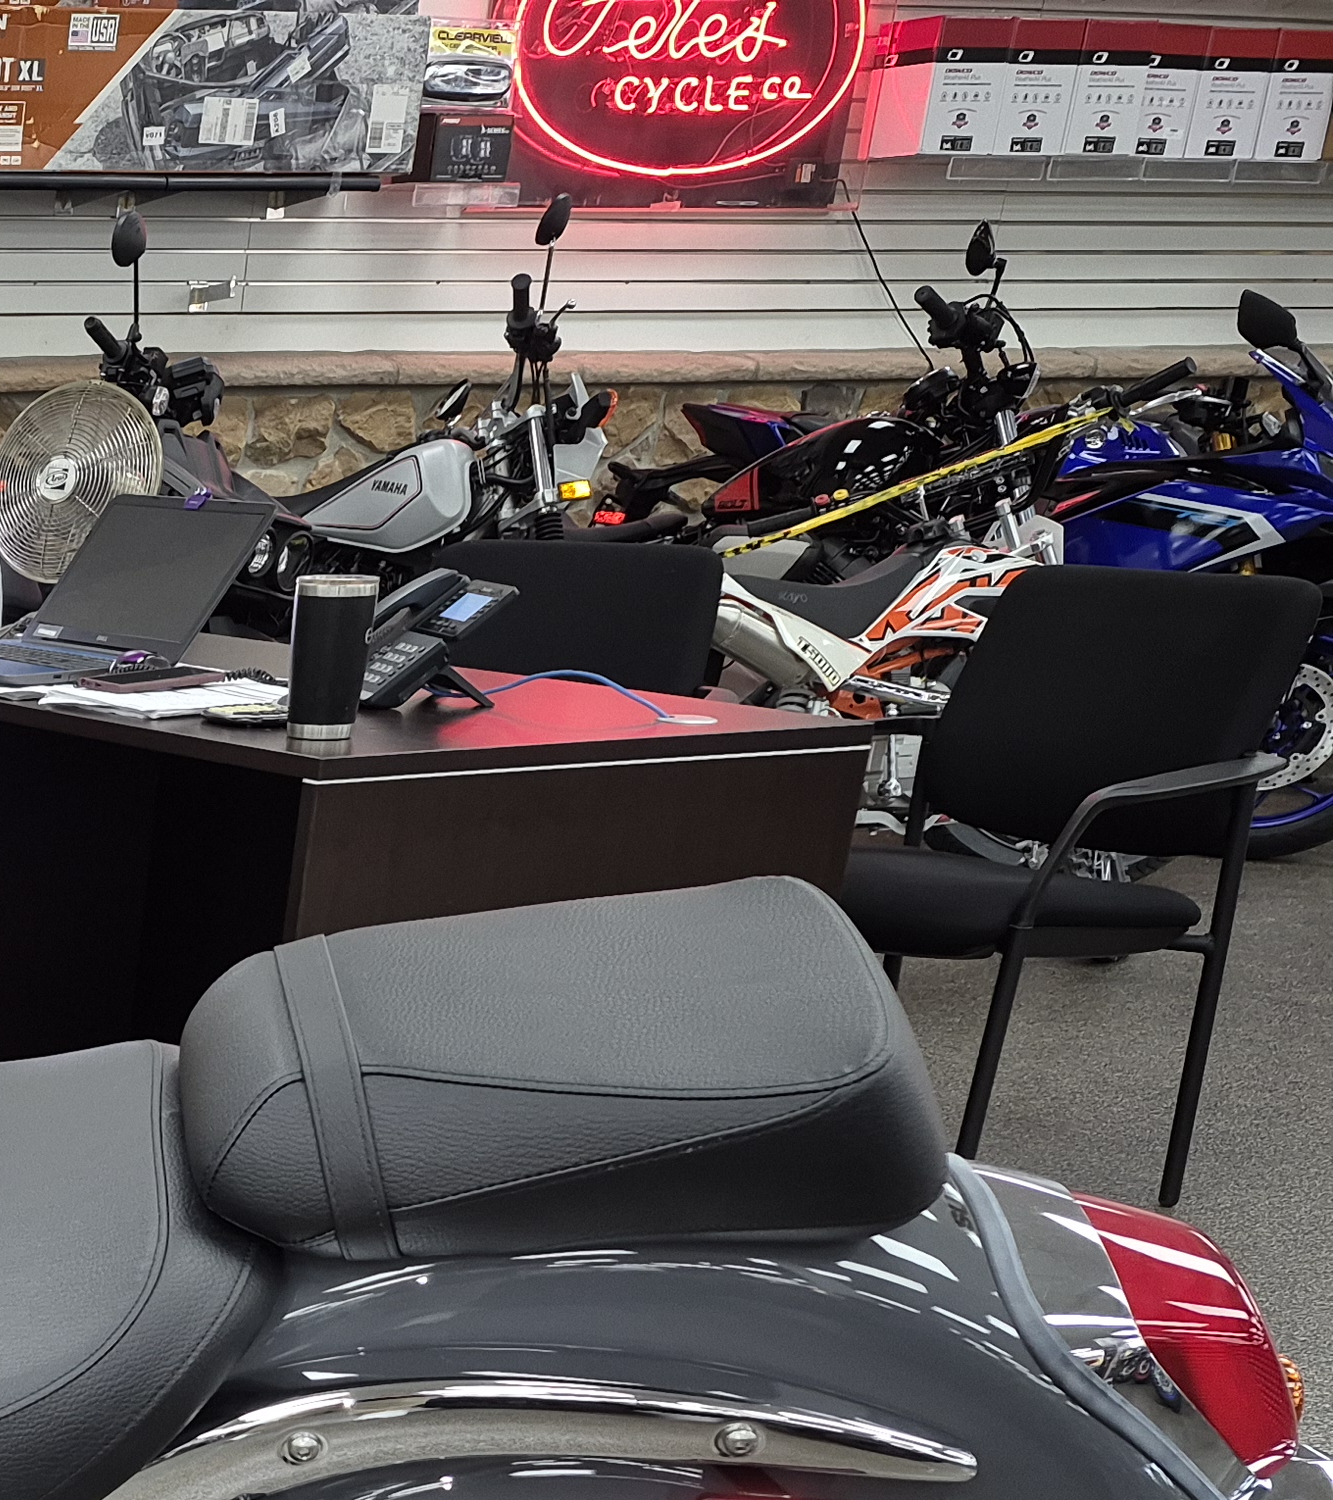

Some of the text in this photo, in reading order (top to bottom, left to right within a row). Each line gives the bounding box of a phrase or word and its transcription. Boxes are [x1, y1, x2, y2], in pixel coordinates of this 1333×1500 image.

[92, 19, 116, 42] USA
[18, 60, 44, 81] XL
[614, 75, 753, 113] CYCLE
[371, 479, 408, 496] YAMAHA
